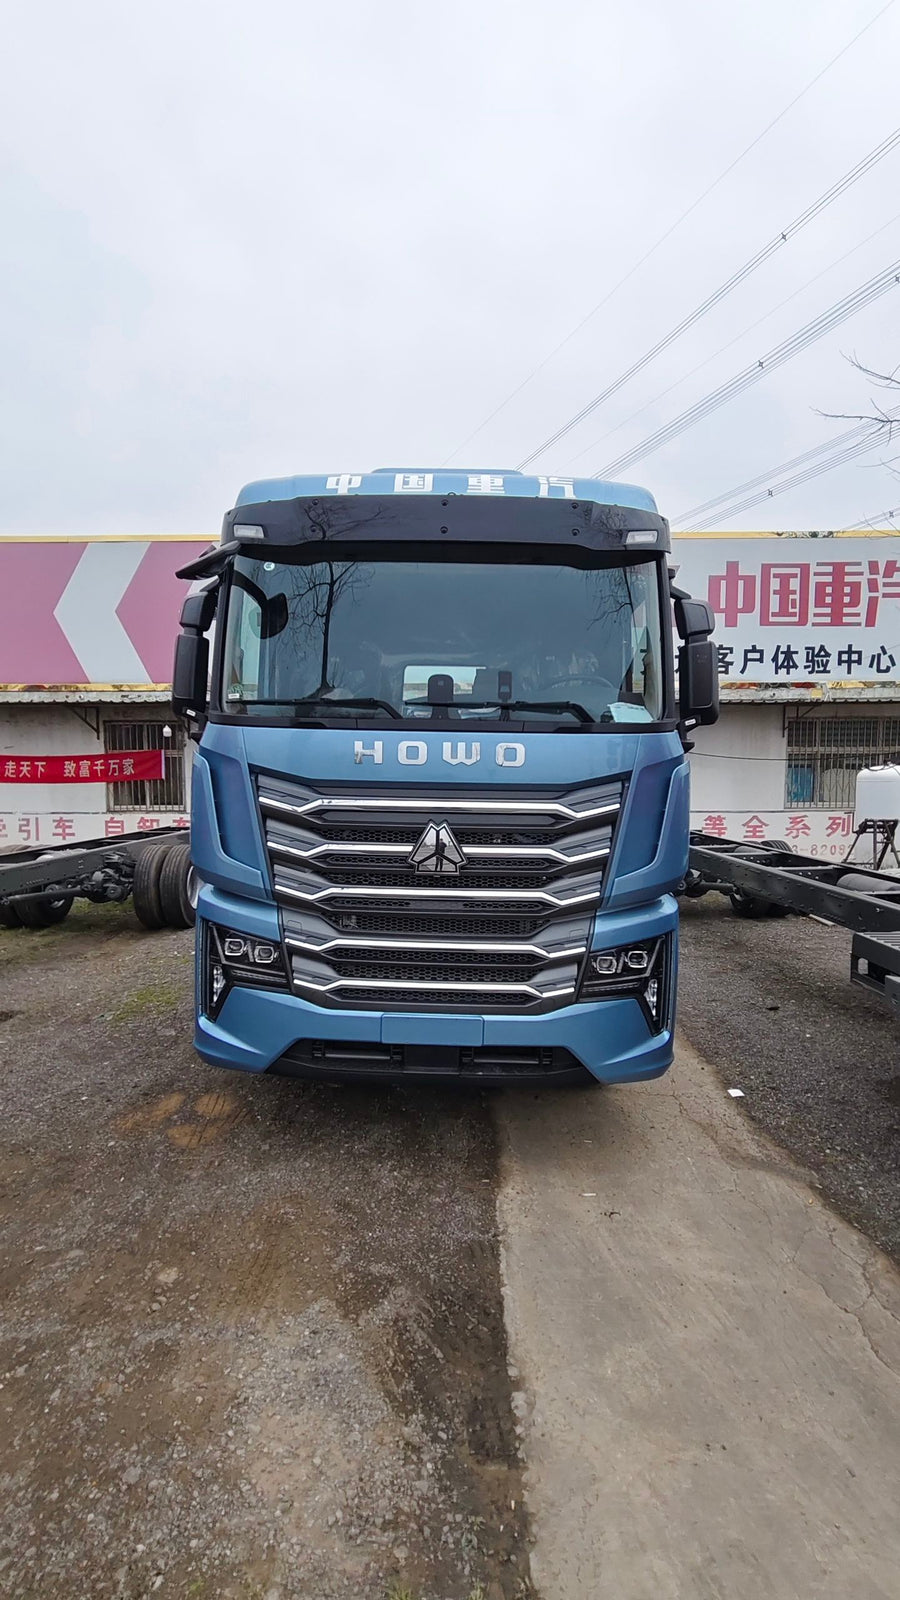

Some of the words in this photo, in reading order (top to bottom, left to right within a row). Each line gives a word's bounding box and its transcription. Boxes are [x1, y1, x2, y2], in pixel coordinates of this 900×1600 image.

[326, 474, 577, 498] 中国重汽
[708, 560, 900, 628] 中国重汽
[675, 644, 896, 675] 客户体验中心
[353, 741, 526, 767] HOWO
[4, 760, 47, 778] 走天下
[63, 758, 135, 778] 致富千万家
[702, 815, 851, 839] 等全系列
